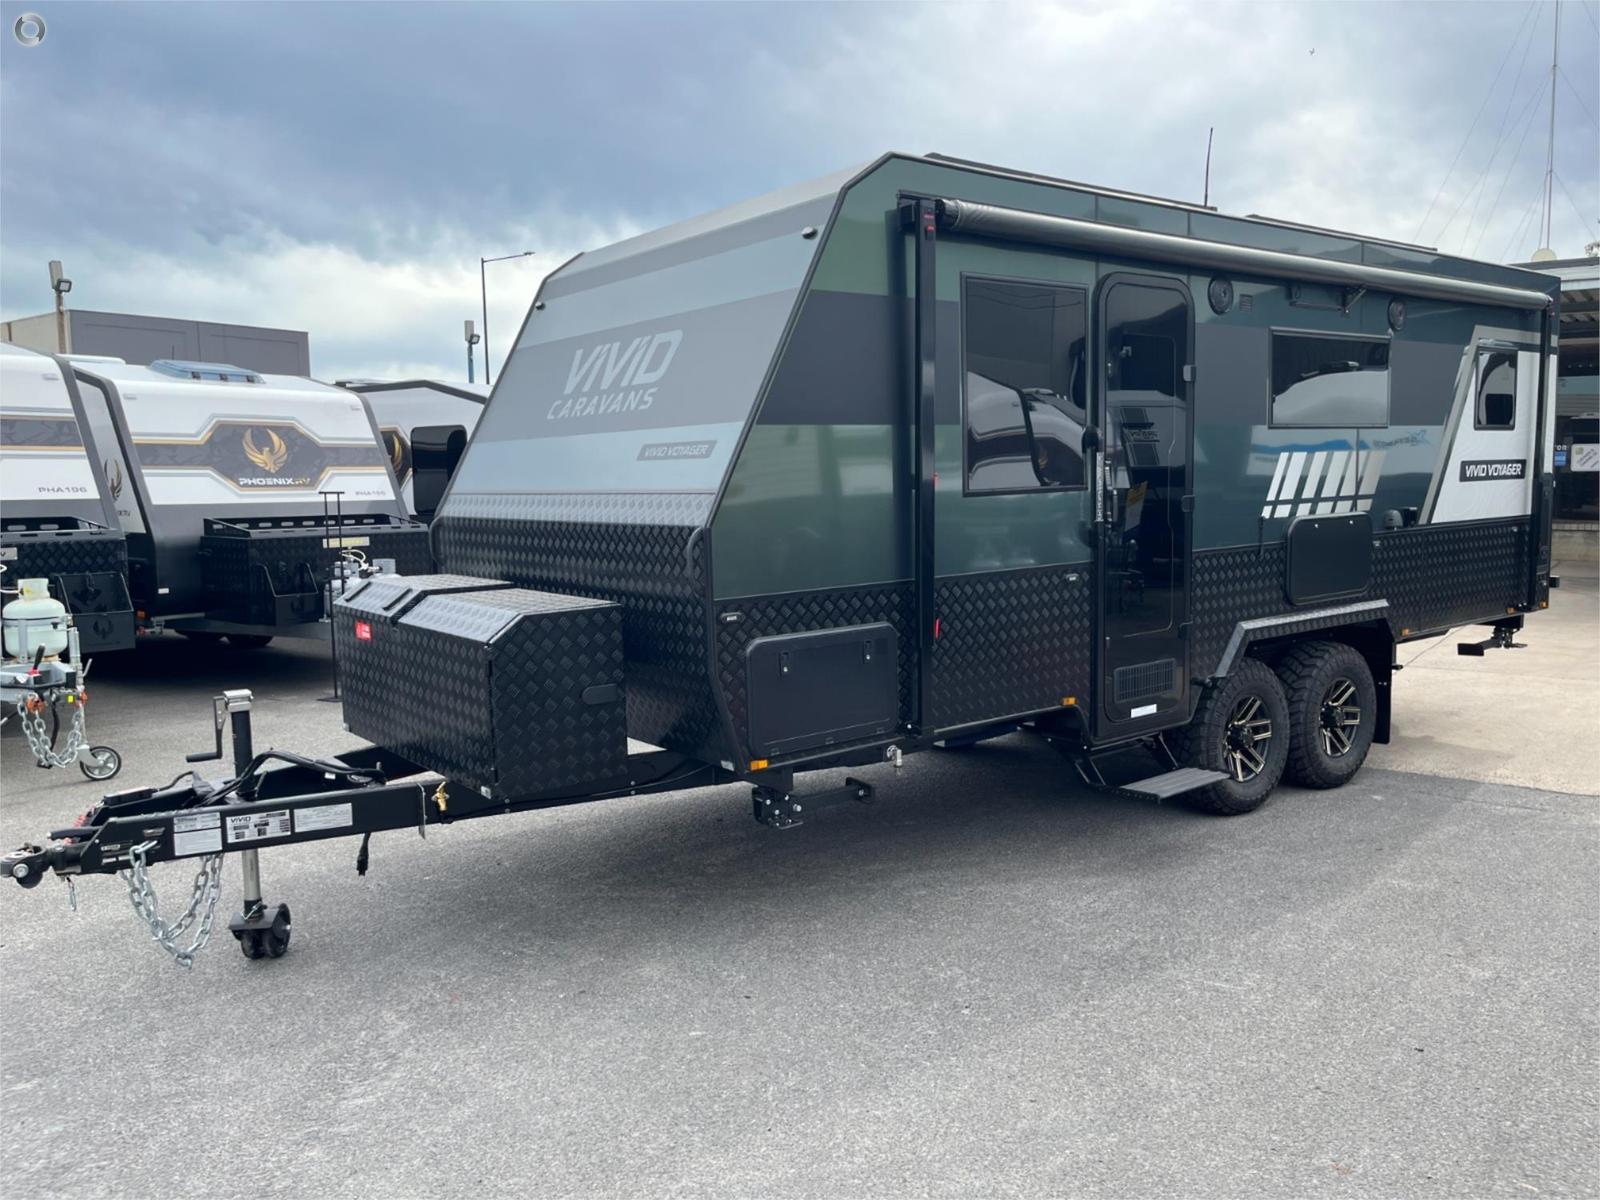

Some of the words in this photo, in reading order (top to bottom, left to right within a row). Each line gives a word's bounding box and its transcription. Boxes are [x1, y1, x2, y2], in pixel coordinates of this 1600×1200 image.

[563, 329, 683, 395] VIVID
[546, 387, 659, 420] CARAVANS
[1465, 464, 1487, 478] VIVID
[1487, 463, 1522, 477] VOYAGER
[239, 477, 295, 486] PHOENIX
[231, 815, 252, 824] VIVID
